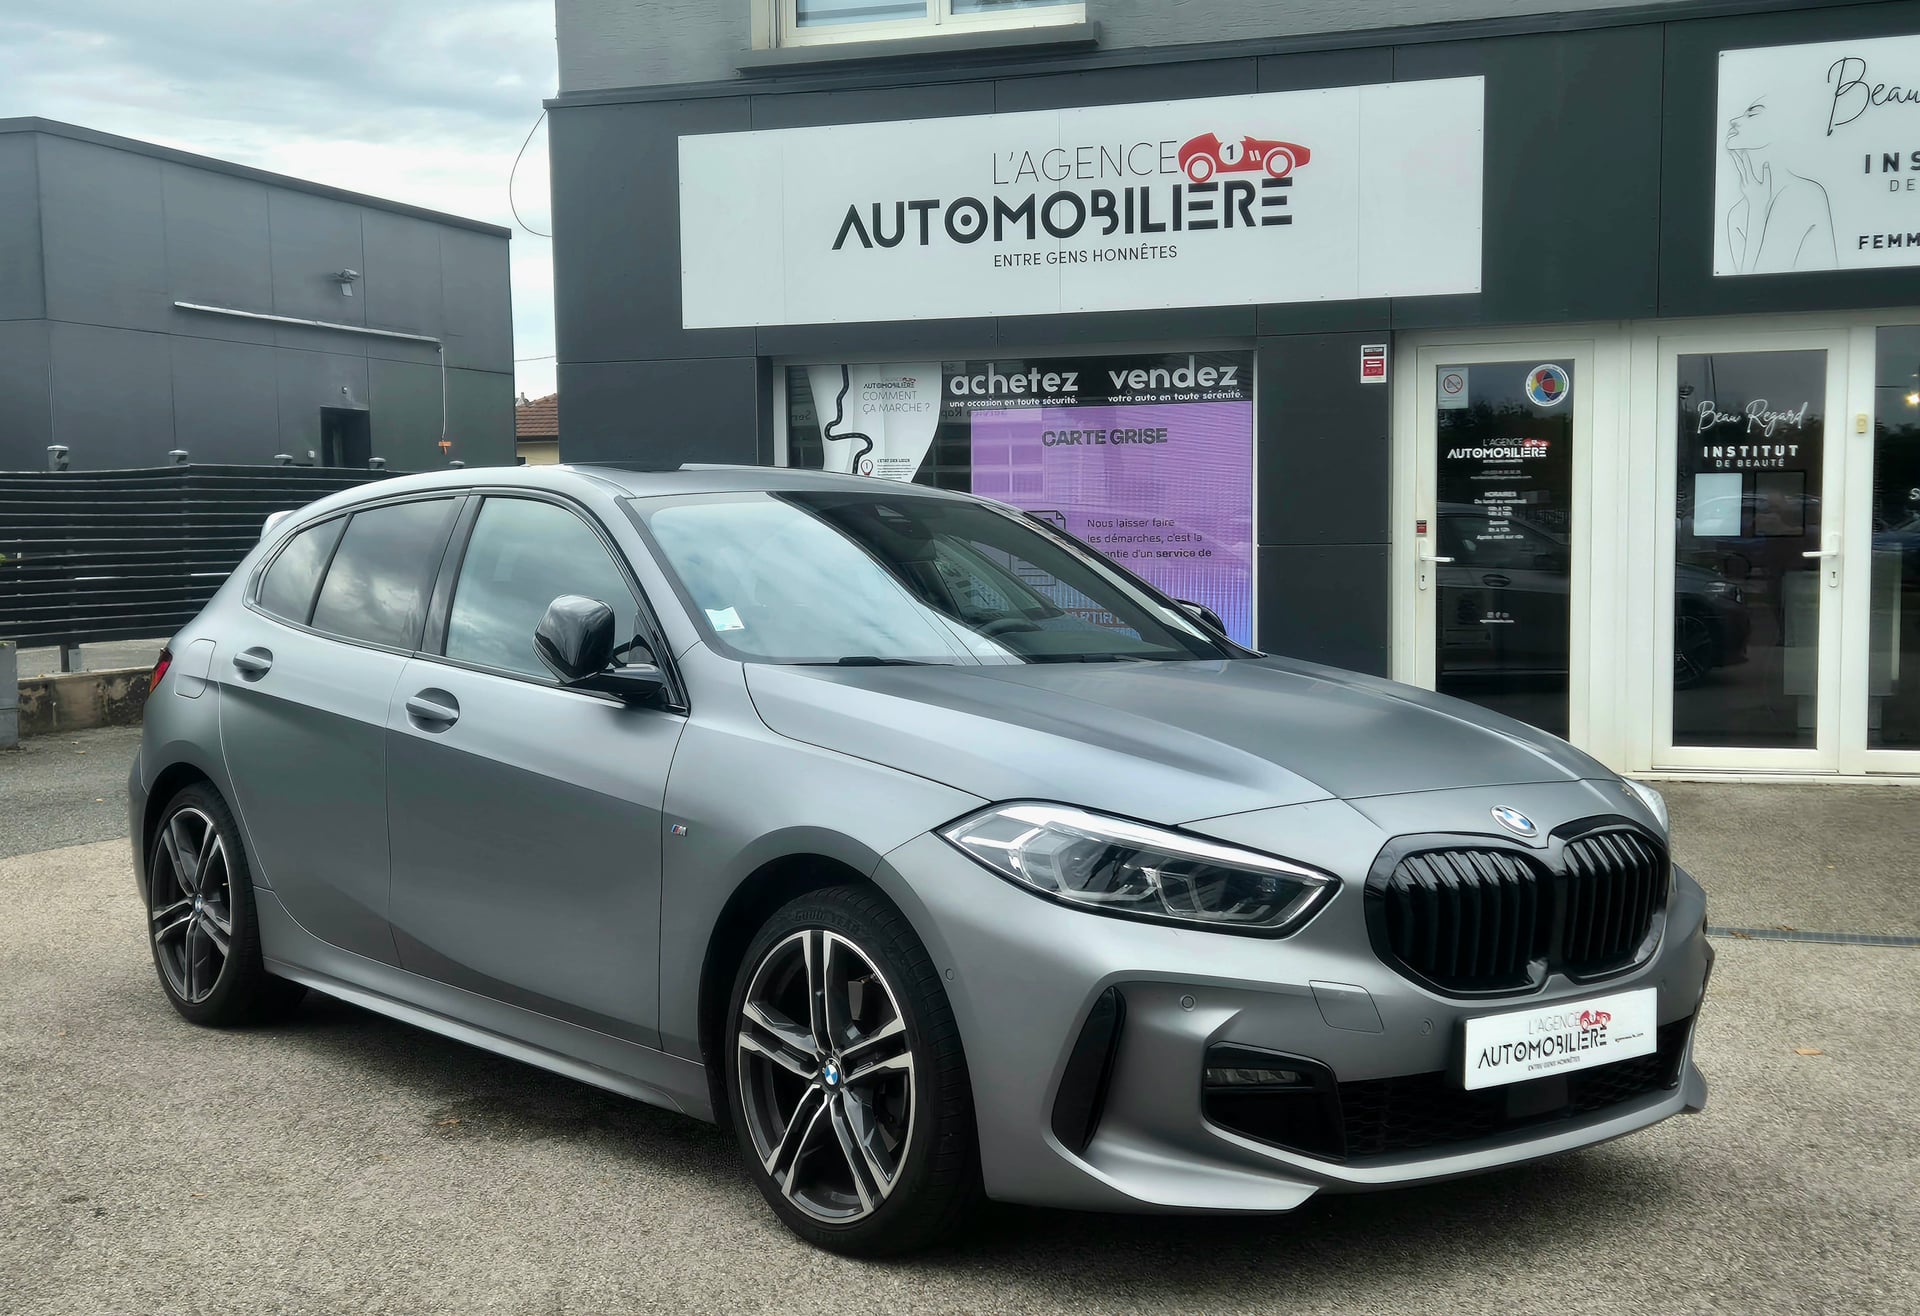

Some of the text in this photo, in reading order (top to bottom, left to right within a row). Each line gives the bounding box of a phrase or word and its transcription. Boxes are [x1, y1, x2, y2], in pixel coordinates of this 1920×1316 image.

[1226, 144, 1234, 160] 1
[993, 140, 1178, 185] L'AGENCE
[1890, 178, 1916, 192] DE
[994, 243, 1178, 267] ENTRE GENS HONNÊTES
[949, 362, 1079, 395] achetez
[1108, 355, 1239, 390] vendez
[862, 390, 917, 401] COMMENT
[967, 398, 1002, 407] occasion
[1017, 397, 1040, 406] toute
[1042, 395, 1079, 405] sécurité.
[1108, 394, 1132, 402] votre
[1134, 393, 1157, 401] auto
[1174, 392, 1200, 400] toute
[1202, 389, 1244, 399] sérénité.
[862, 402, 931, 415] ÇA MARCHE ?
[1697, 399, 1808, 437] Beau Regard
[1041, 427, 1168, 447] CARTE GRISE
[1482, 438, 1523, 446] L'AGENCE
[1703, 445, 1798, 458] INSTITUT
[1716, 458, 1785, 468] DE BEAUTÉ
[1087, 518, 1175, 528] Nous laisser faire
[1087, 533, 1203, 544] les démarches, c'est la
[1104, 548, 1212, 558] antie d'un service de
[1528, 1011, 1581, 1035] L'AGENCE
